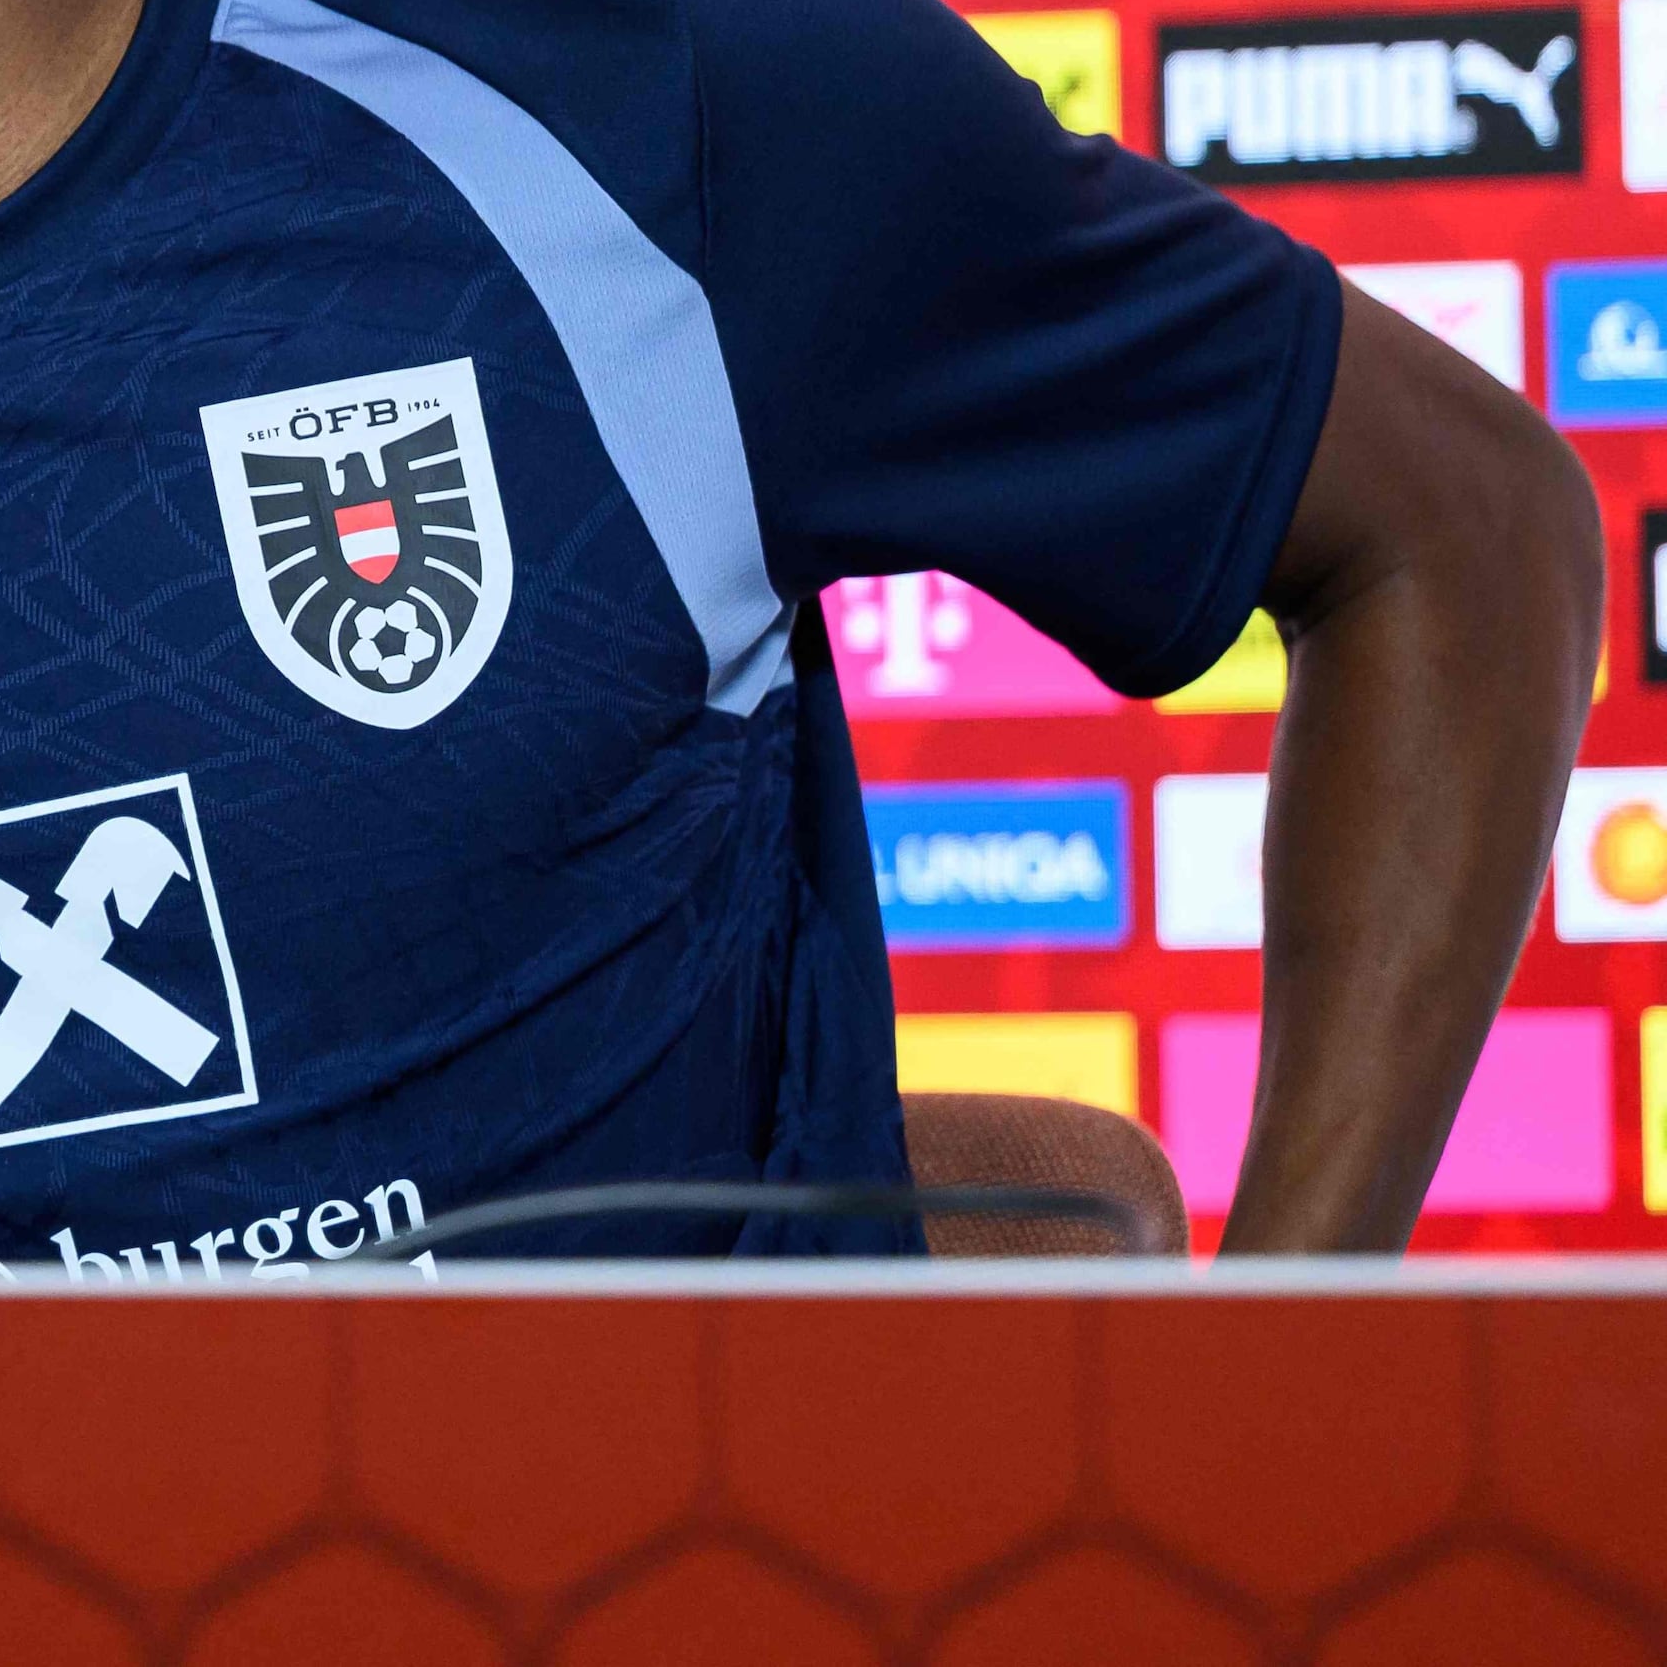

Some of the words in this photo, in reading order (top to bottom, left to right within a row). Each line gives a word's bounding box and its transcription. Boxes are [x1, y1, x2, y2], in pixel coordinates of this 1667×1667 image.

[1165, 43, 1457, 165] PUMA
[247, 427, 281, 442] SEIT
[288, 398, 399, 441] ÖFB
[407, 398, 441, 413] 1904
[49, 1177, 433, 1286] burgen
